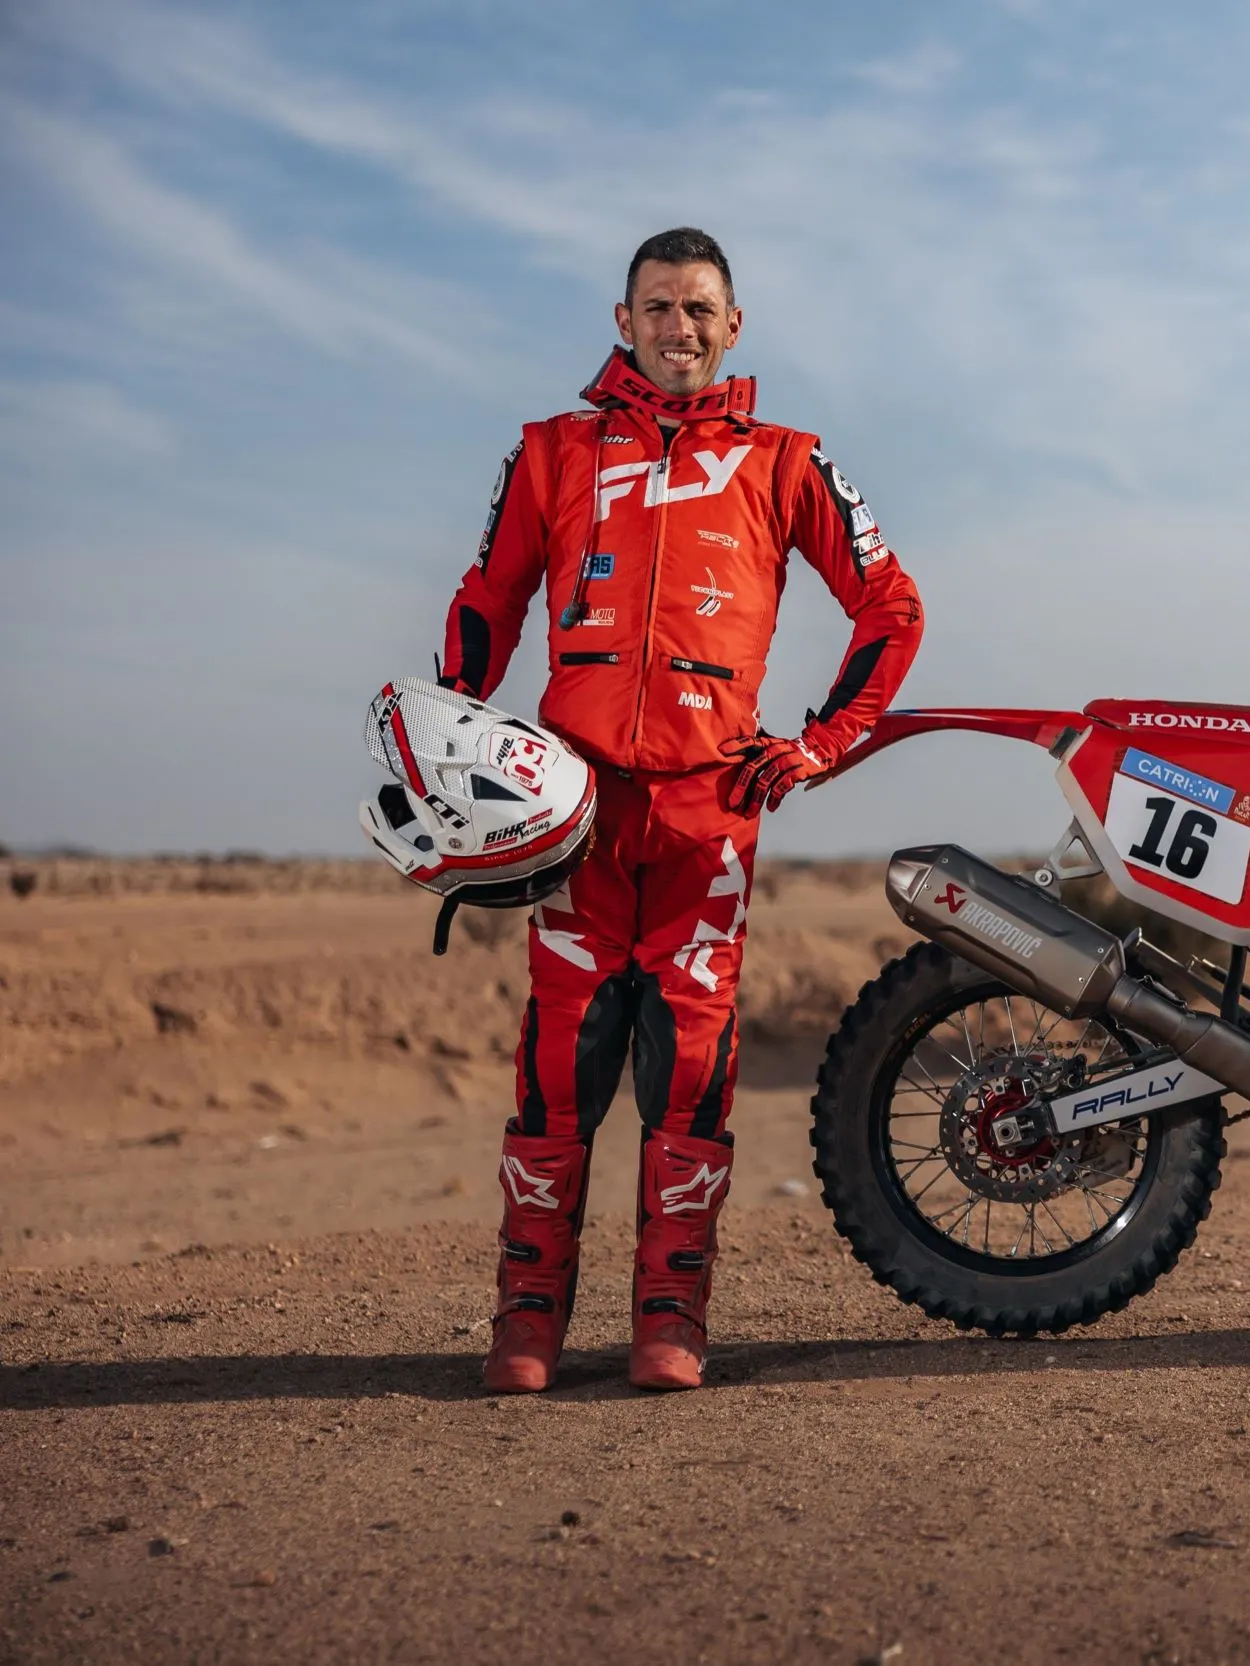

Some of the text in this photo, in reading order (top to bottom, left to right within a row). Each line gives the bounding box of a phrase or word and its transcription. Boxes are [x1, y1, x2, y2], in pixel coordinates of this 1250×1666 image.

[594, 445, 753, 523] FLY
[678, 692, 713, 711] MDA
[1128, 796, 1218, 880] 16
[1072, 1072, 1184, 1120] RALLY
